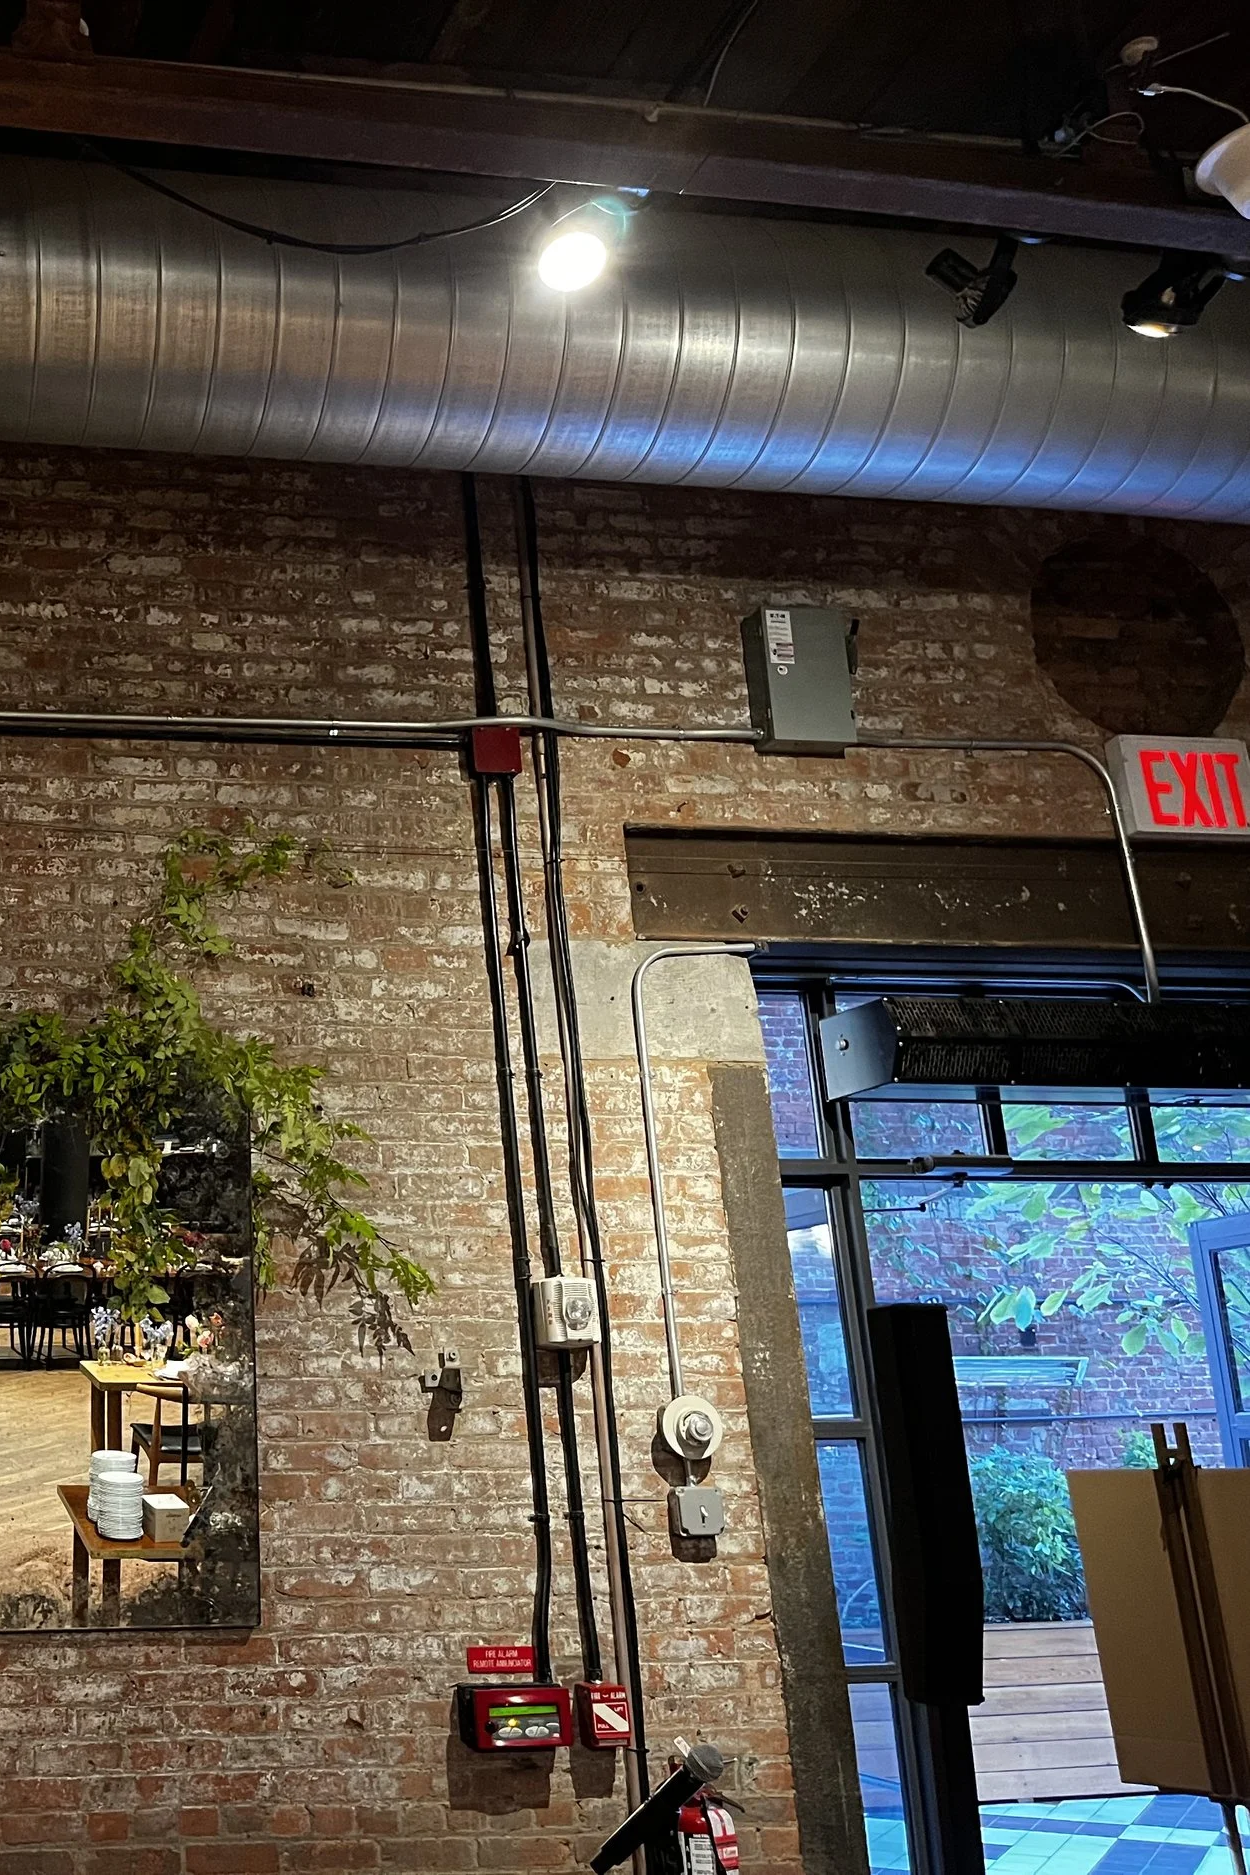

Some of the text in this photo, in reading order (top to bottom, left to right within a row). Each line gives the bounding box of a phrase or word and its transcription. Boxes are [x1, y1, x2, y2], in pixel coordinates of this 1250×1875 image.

[1138, 749, 1247, 828] EXIT
[485, 1649, 519, 1659] FIRE ALARM
[473, 1659, 495, 1668] REMOTE
